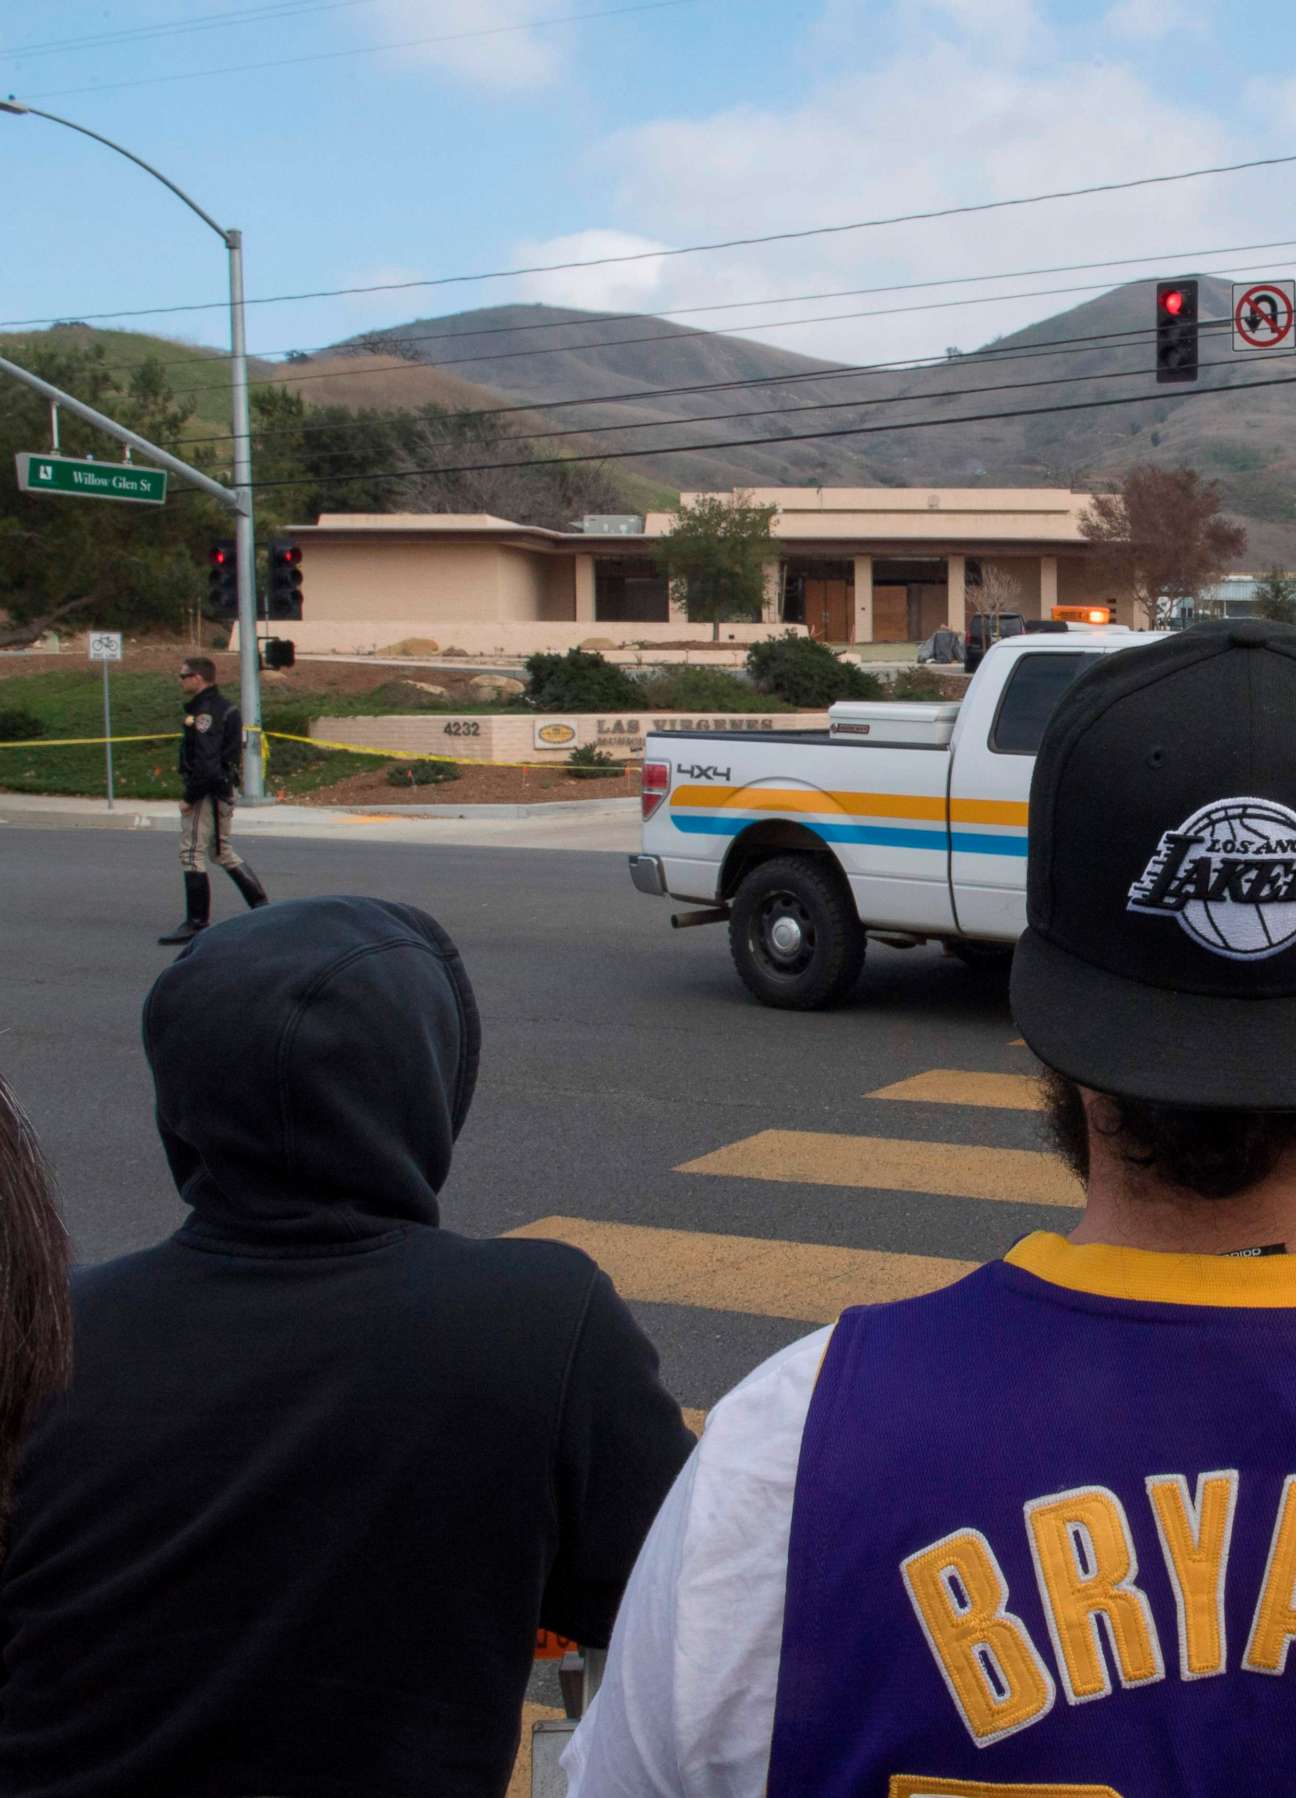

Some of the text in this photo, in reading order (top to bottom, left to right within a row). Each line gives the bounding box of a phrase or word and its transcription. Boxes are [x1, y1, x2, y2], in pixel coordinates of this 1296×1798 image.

[73, 470, 152, 492] Willow Glen St
[443, 721, 481, 737] 4232
[597, 719, 773, 734] LAS VIRGENES
[1206, 839, 1254, 853] LOS
